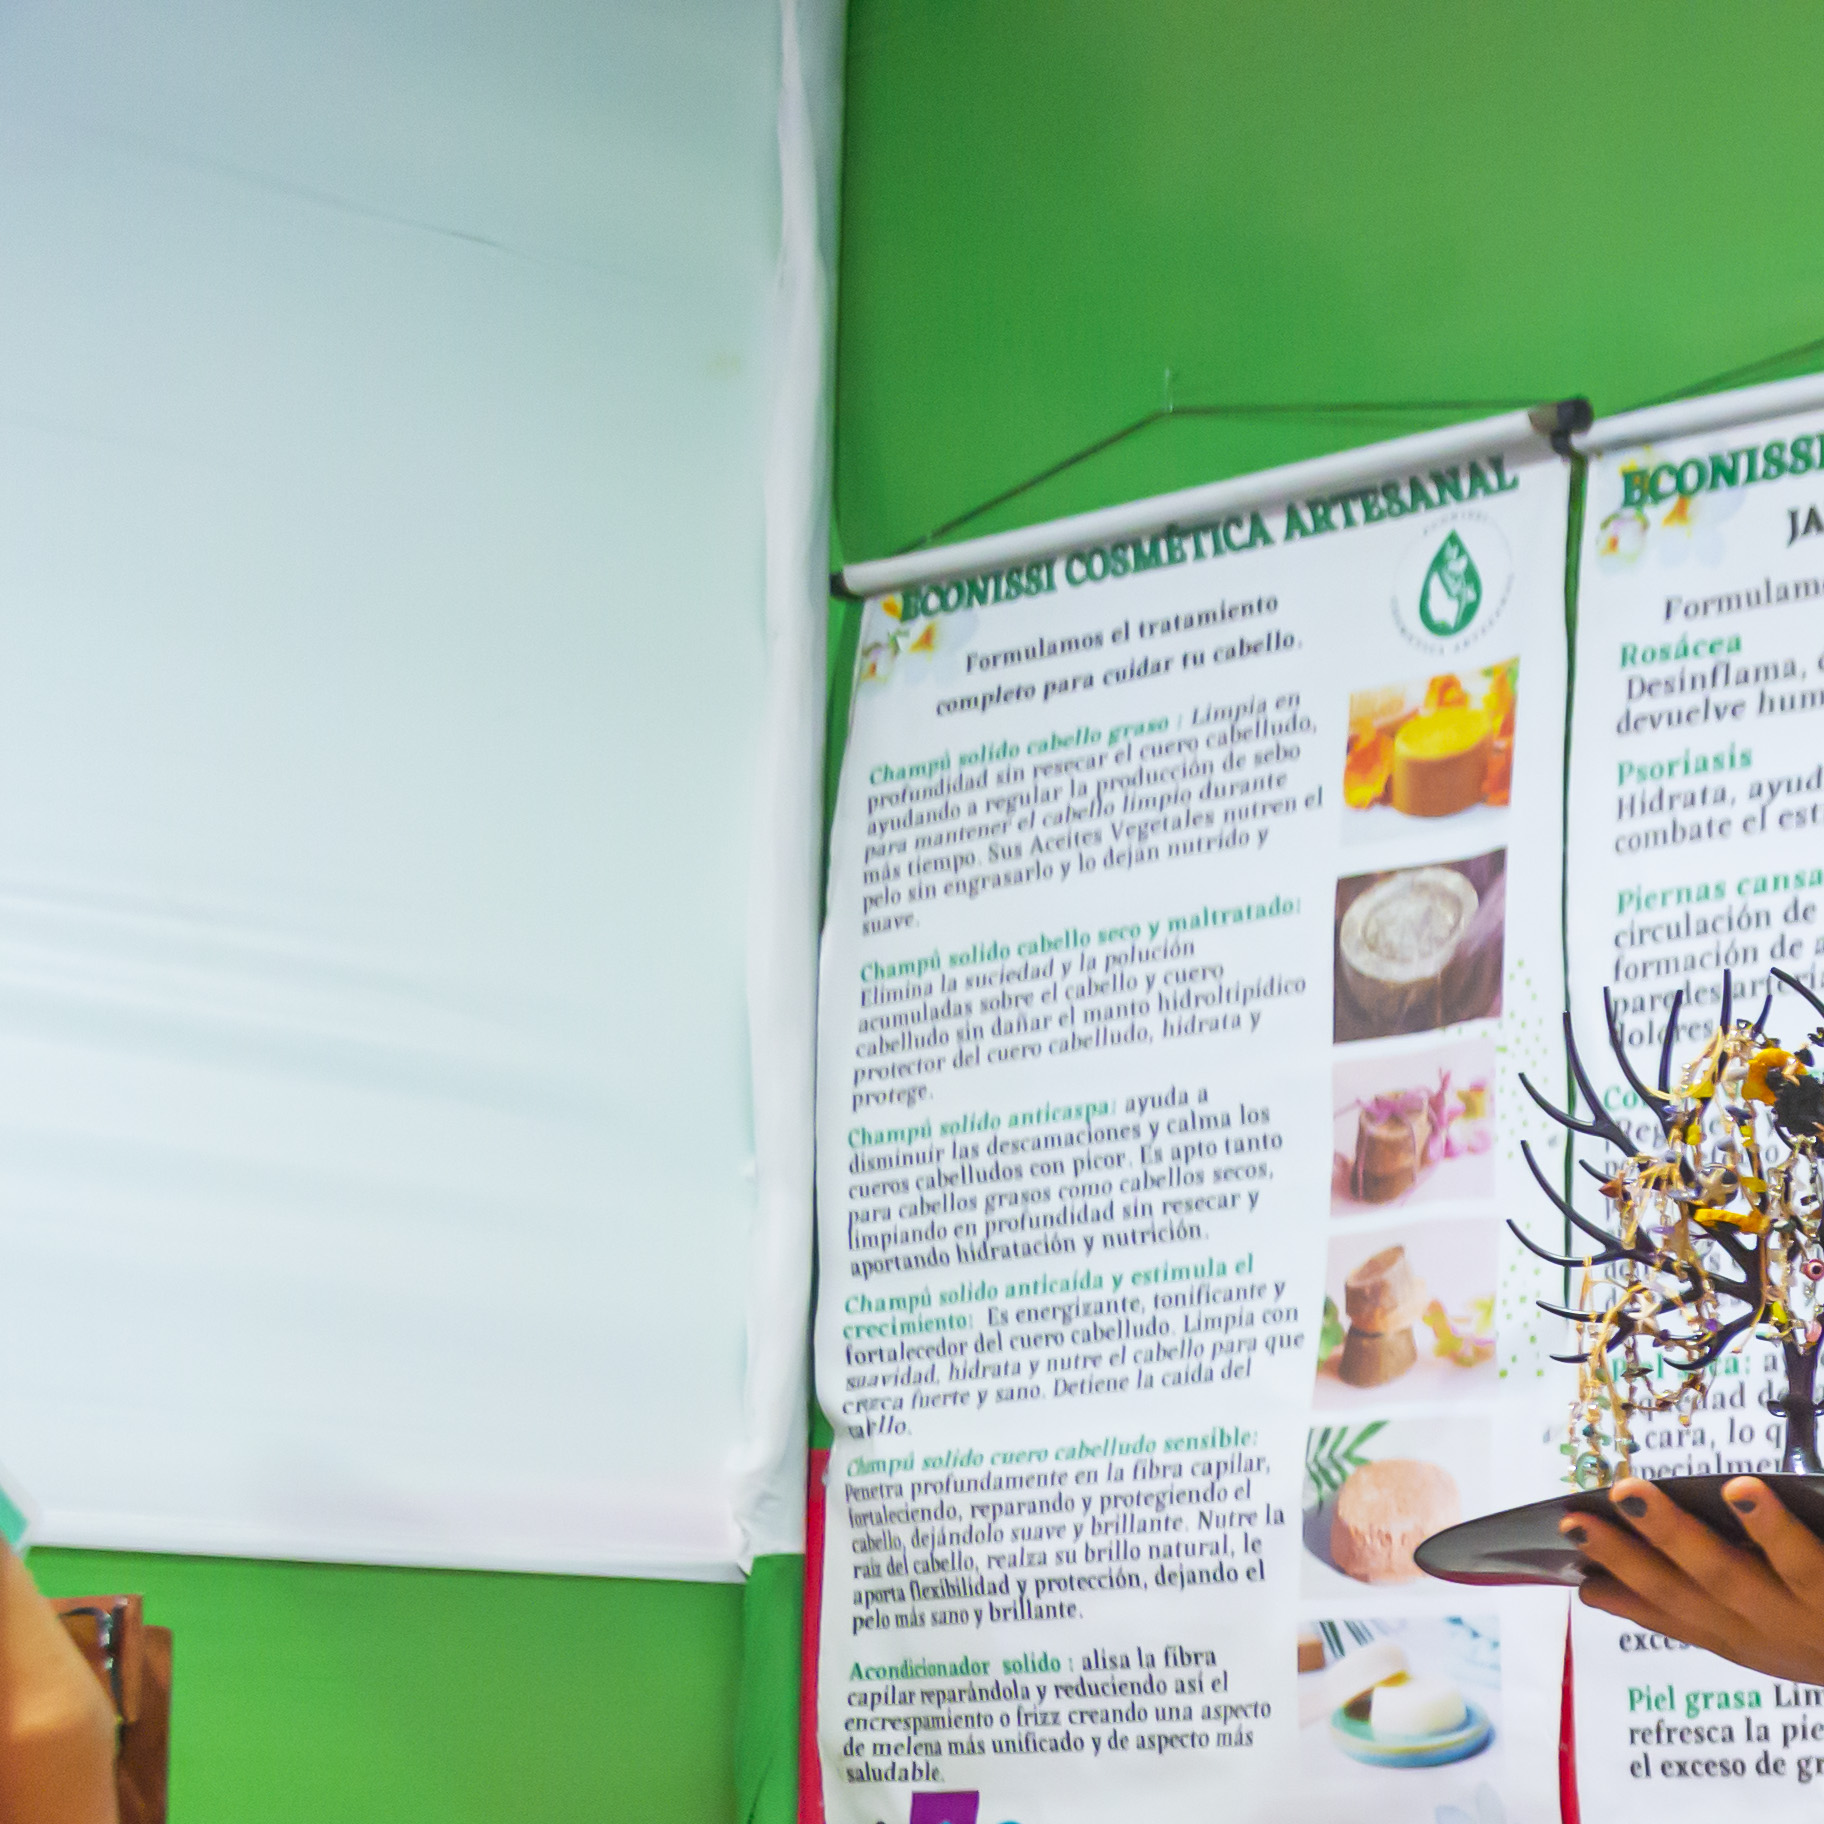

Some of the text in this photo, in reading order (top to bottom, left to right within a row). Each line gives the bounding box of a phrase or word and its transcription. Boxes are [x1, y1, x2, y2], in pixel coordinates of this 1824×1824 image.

[897, 558, 1056, 623] ECONISSI
[1284, 459, 1519, 541] ARTESANAL
[966, 597, 1278, 673] Formulamos el tratamiento
[1619, 634, 1742, 671] Rosácea
[936, 685, 1036, 717] completo
[1042, 674, 1094, 702] para
[1102, 657, 1172, 685] cuidar
[1180, 652, 1205, 670] tu
[1026, 726, 1102, 756] cabello
[1191, 696, 1266, 726] Limpia
[1274, 692, 1300, 711] en
[1616, 698, 1746, 737] devuelve
[1616, 745, 1752, 787] Psoriasis
[1616, 787, 1736, 822] Hidrata,
[1614, 819, 1732, 855] combate
[1741, 807, 1766, 835] el
[1616, 882, 1726, 914] Piernas
[1016, 929, 1090, 957] cabello
[1096, 924, 1141, 944] seco
[1147, 921, 1160, 942] y
[1613, 905, 1771, 948] circulación
[1782, 899, 1816, 925] de
[1612, 941, 1758, 982] formación
[1769, 934, 1803, 961] de
[1124, 1088, 1188, 1117] ayuda
[1197, 1088, 1208, 1103] a
[850, 1249, 950, 1281] aportando
[956, 1235, 1075, 1265] hidratación
[1082, 1237, 1094, 1257] y
[1111, 1273, 1122, 1293] y
[1234, 1254, 1253, 1275] el
[851, 1611, 890, 1636] pelo
[894, 1609, 926, 1628] más
[930, 1610, 969, 1626] sano
[973, 1610, 982, 1629] y
[848, 1659, 990, 1682] Acondicionador
[1082, 1652, 1130, 1671] alisa
[1137, 1650, 1156, 1669] la
[846, 1688, 916, 1712] capilar
[1036, 1686, 1046, 1706] y
[1053, 1676, 1167, 1699] reduciendo
[1210, 1672, 1228, 1692] el
[1628, 1685, 1676, 1712] Piel
[1686, 1693, 1762, 1718] grasa
[999, 1713, 1010, 1727] o
[1067, 1703, 1148, 1724] creando
[1154, 1706, 1192, 1722] una
[1629, 1717, 1734, 1746] refresca
[1746, 1716, 1770, 1743] la
[840, 1739, 864, 1757] de
[871, 1737, 942, 1756] melena
[947, 1735, 985, 1754] más
[991, 1732, 1084, 1753] unificado
[1091, 1736, 1101, 1756] y
[1106, 1730, 1128, 1749] de
[1216, 1726, 1253, 1746] más
[1630, 1752, 1652, 1779] el
[1660, 1758, 1747, 1778] exceso
[1755, 1749, 1787, 1776] de
